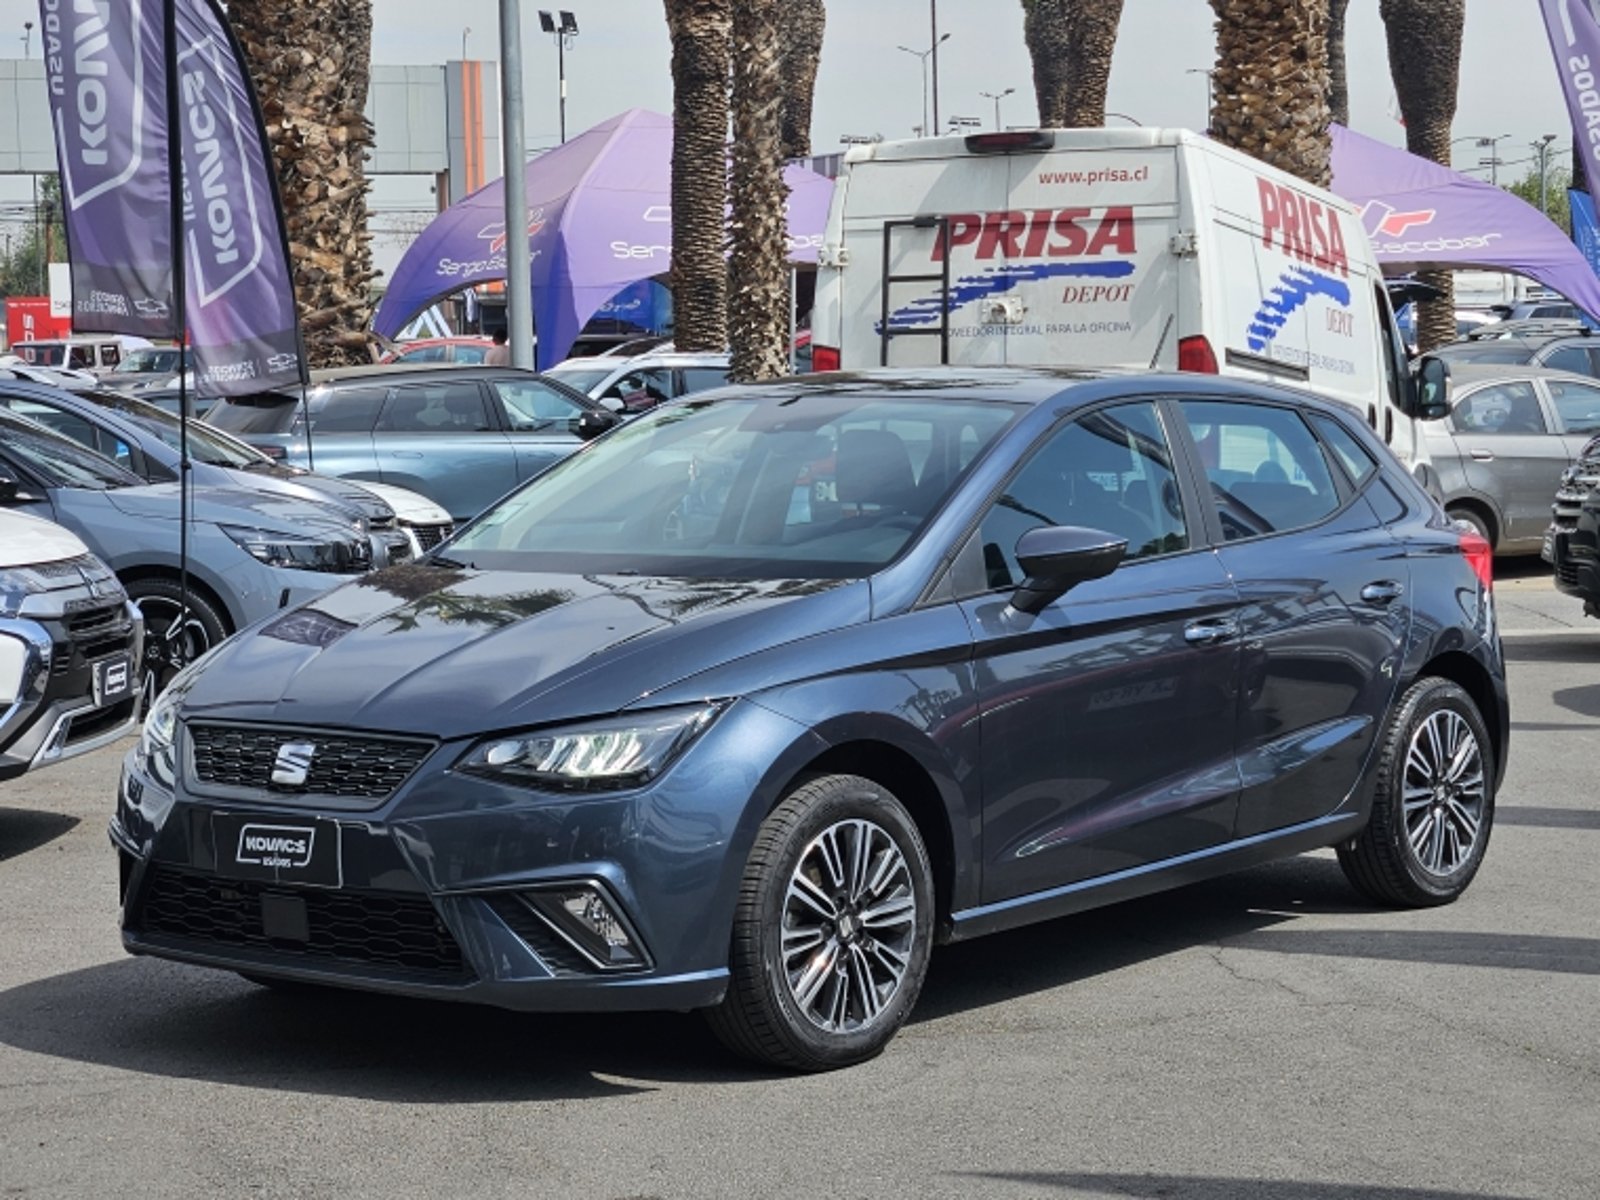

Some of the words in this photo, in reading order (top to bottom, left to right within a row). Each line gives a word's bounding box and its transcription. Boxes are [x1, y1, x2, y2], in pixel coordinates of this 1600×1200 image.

[1039, 166, 1148, 186] www.prisa.cl
[930, 206, 1137, 261] PRISA
[1256, 176, 1348, 278] PRISA
[1062, 284, 1135, 304] DEPOT
[245, 836, 306, 854] KOVACS
